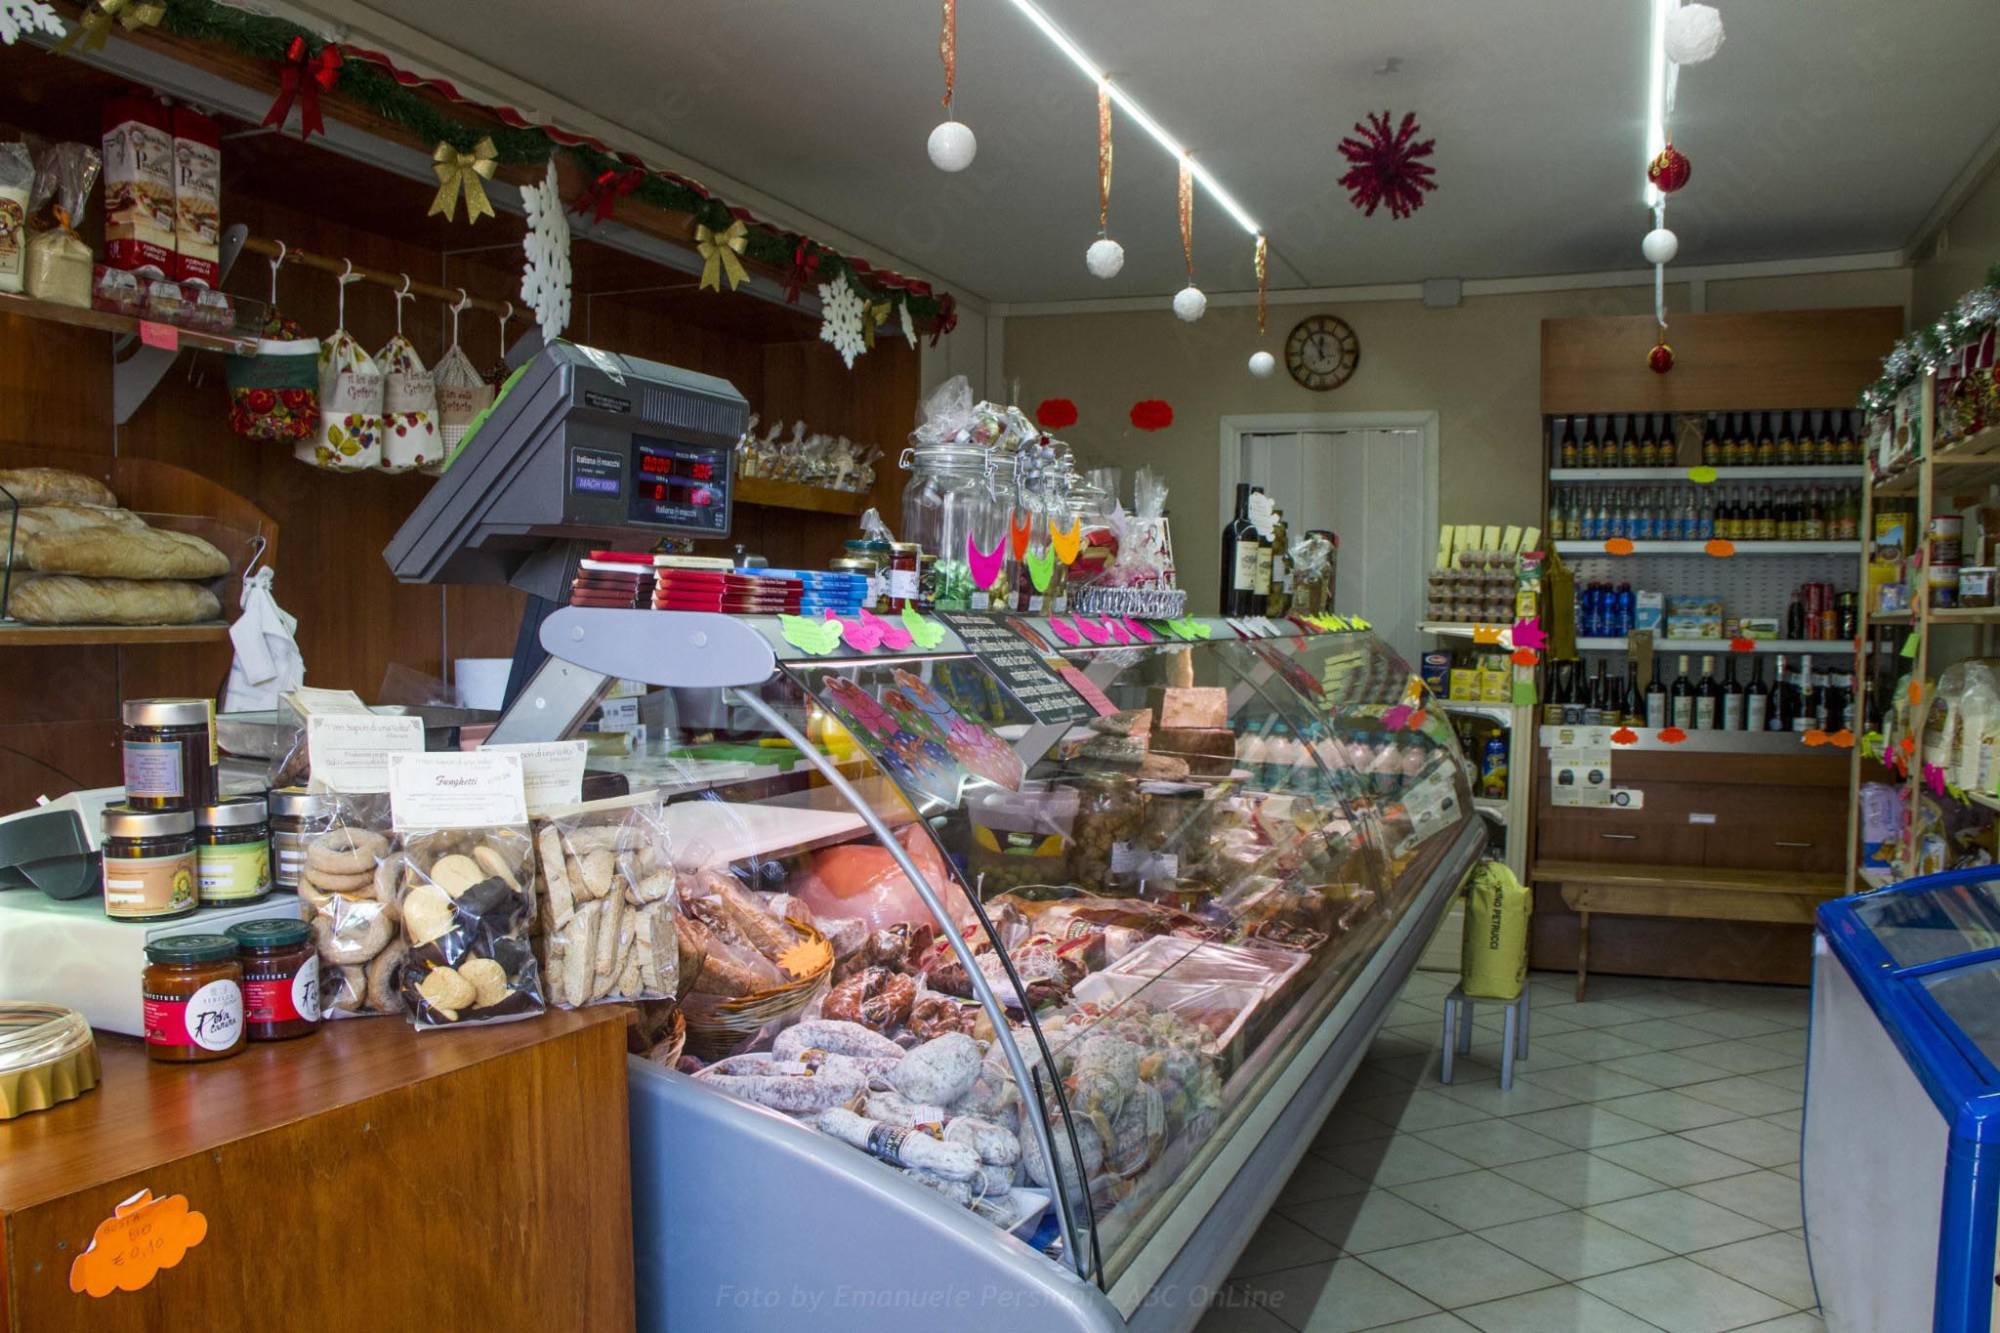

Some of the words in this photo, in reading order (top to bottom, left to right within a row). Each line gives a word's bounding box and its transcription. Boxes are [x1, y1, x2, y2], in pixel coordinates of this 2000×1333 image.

[435, 775, 479, 789] Funghetti
[1489, 909, 1502, 950] PETRUCCI
[128, 1222, 153, 1241] BIO
